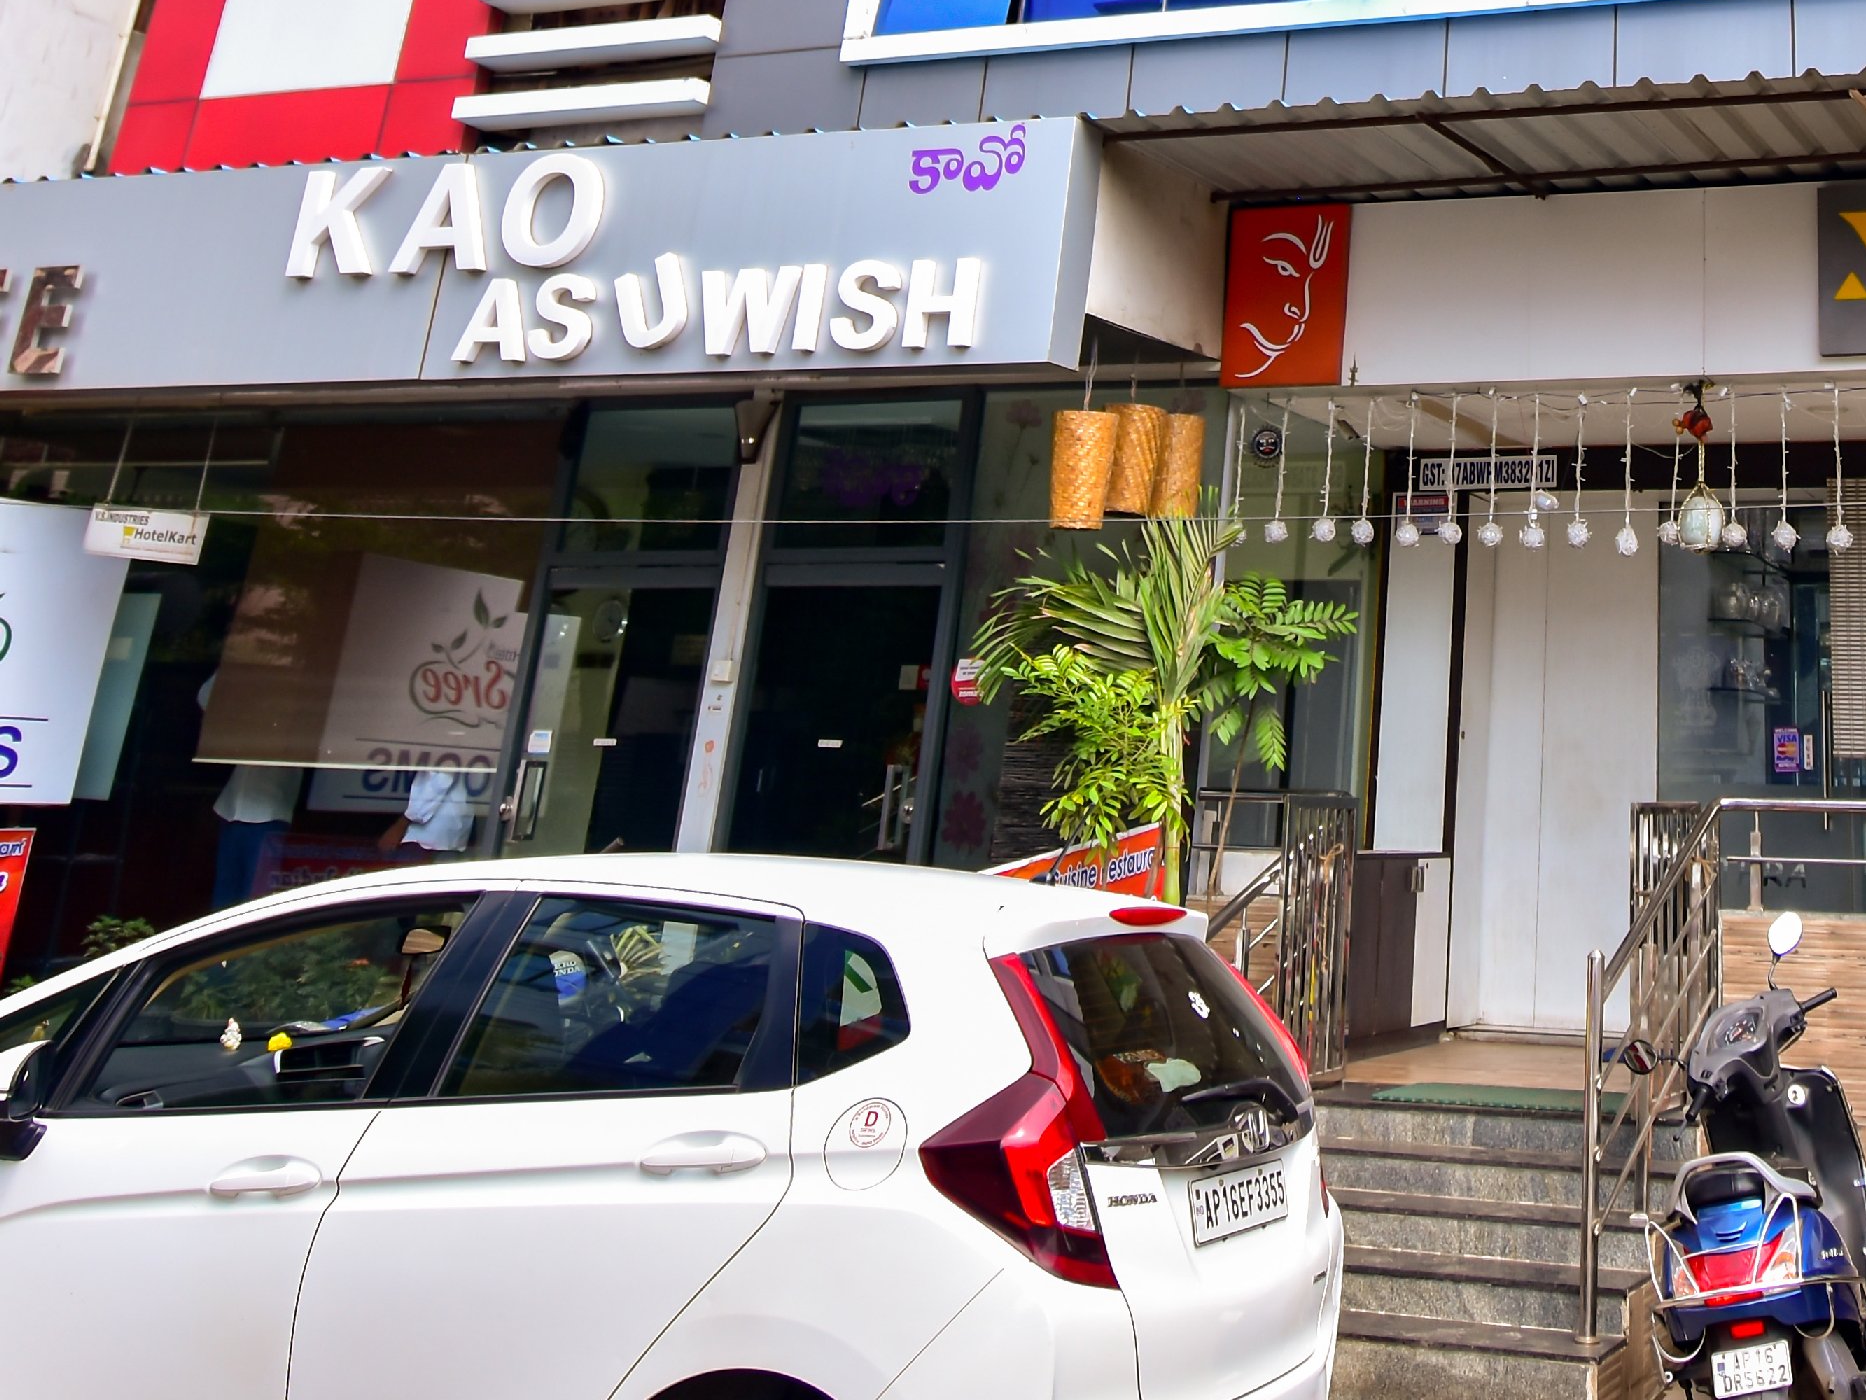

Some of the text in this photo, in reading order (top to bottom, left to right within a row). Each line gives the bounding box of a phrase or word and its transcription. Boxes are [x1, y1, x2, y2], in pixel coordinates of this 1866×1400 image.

[285, 153, 607, 280] KAO
[452, 252, 982, 363] ASUWISH
[1422, 463, 1445, 486] GST:
[1404, 497, 1446, 506] ARNING
[134, 527, 197, 546] HotelKart
[1777, 734, 1797, 743] VISA
[1107, 1192, 1157, 1208] HONDA
